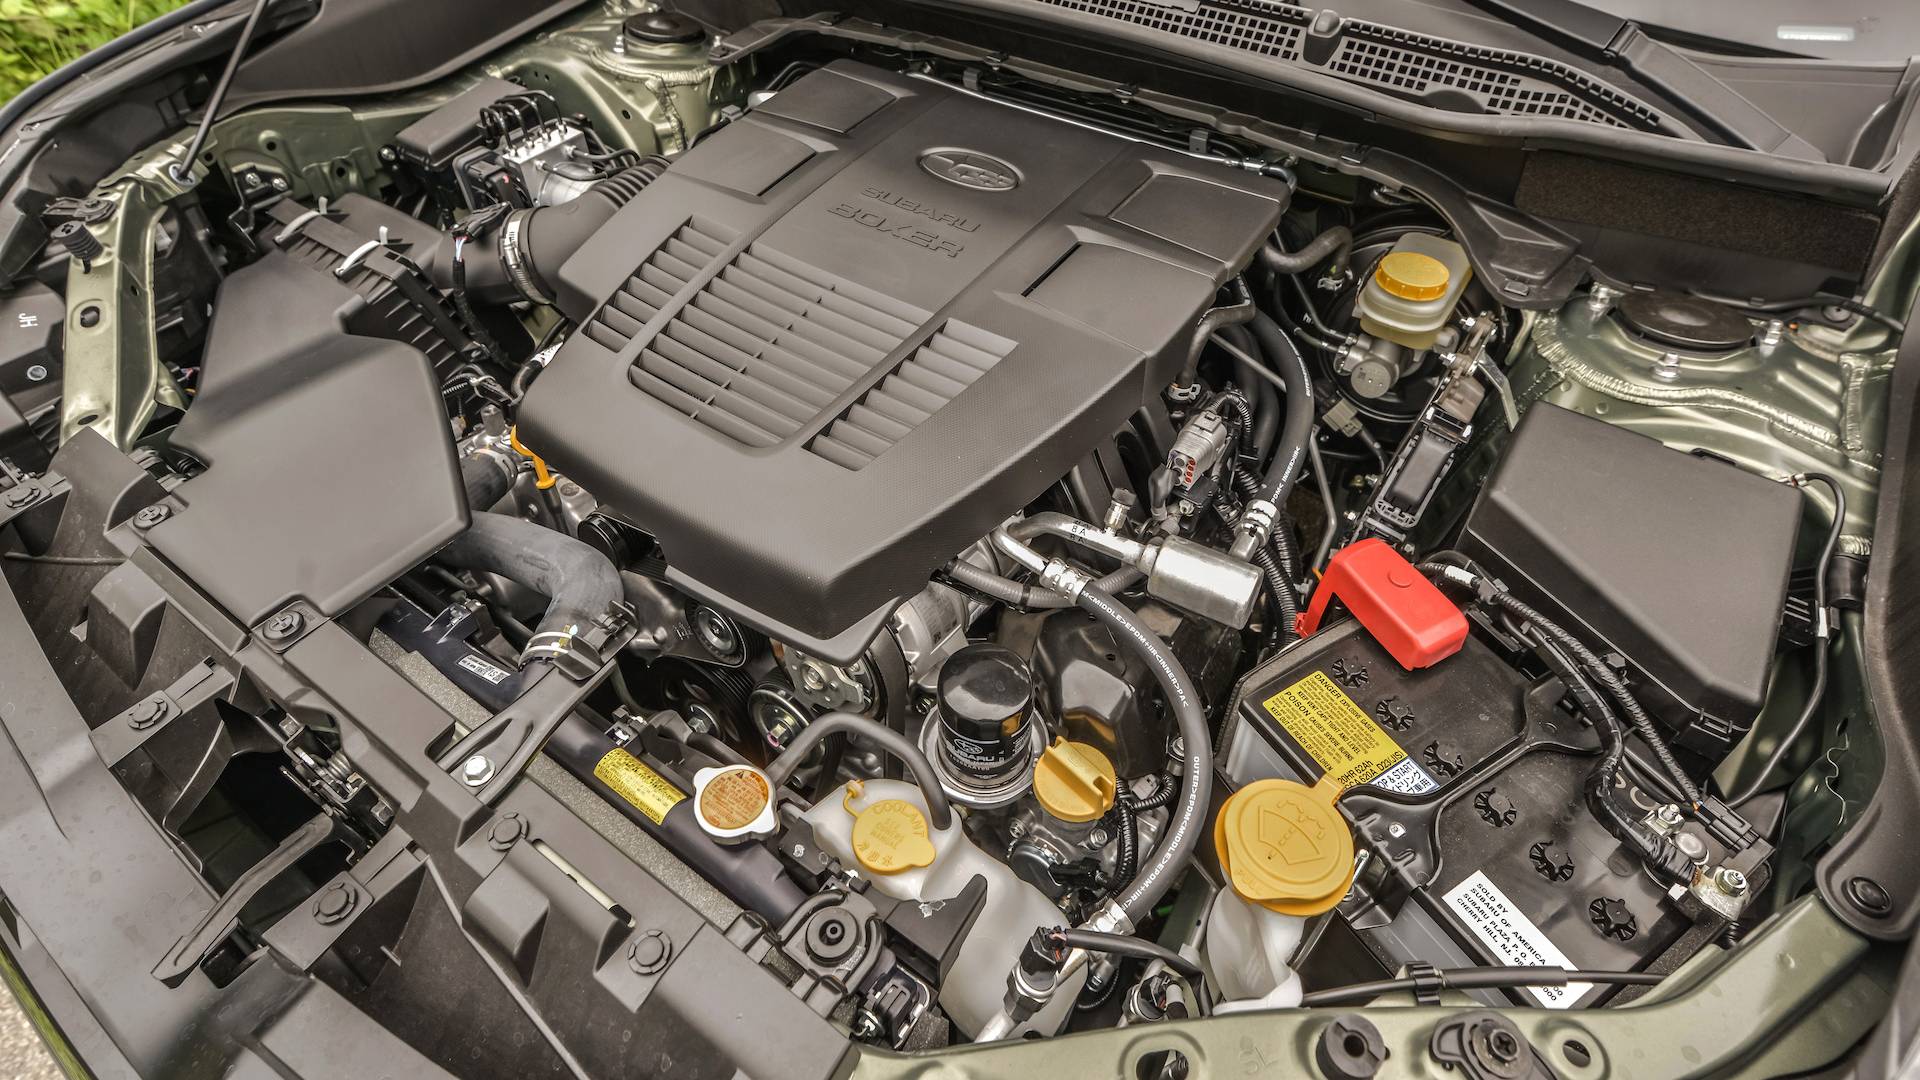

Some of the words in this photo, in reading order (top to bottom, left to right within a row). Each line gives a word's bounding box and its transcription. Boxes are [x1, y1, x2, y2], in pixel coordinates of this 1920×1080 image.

[861, 185, 982, 233] SUBARU
[827, 203, 965, 258] BOXER
[1314, 673, 1342, 700] DANGER
[1284, 691, 1311, 717] POISON
[1337, 769, 1357, 785] 20HR
[1355, 759, 1374, 776] 62Ah
[1359, 768, 1378, 784] 620A
[1394, 761, 1416, 780] START
[1456, 897, 1483, 923] CHERRY
[1476, 882, 1496, 903] SOLD
[1496, 903, 1509, 914] BY
[1463, 893, 1490, 920] SUBARU
[1490, 920, 1511, 943] PLAZA
[1470, 887, 1501, 917] SUBARU
[1500, 918, 1513, 929] OF
[1511, 931, 1547, 965] AMERICA
